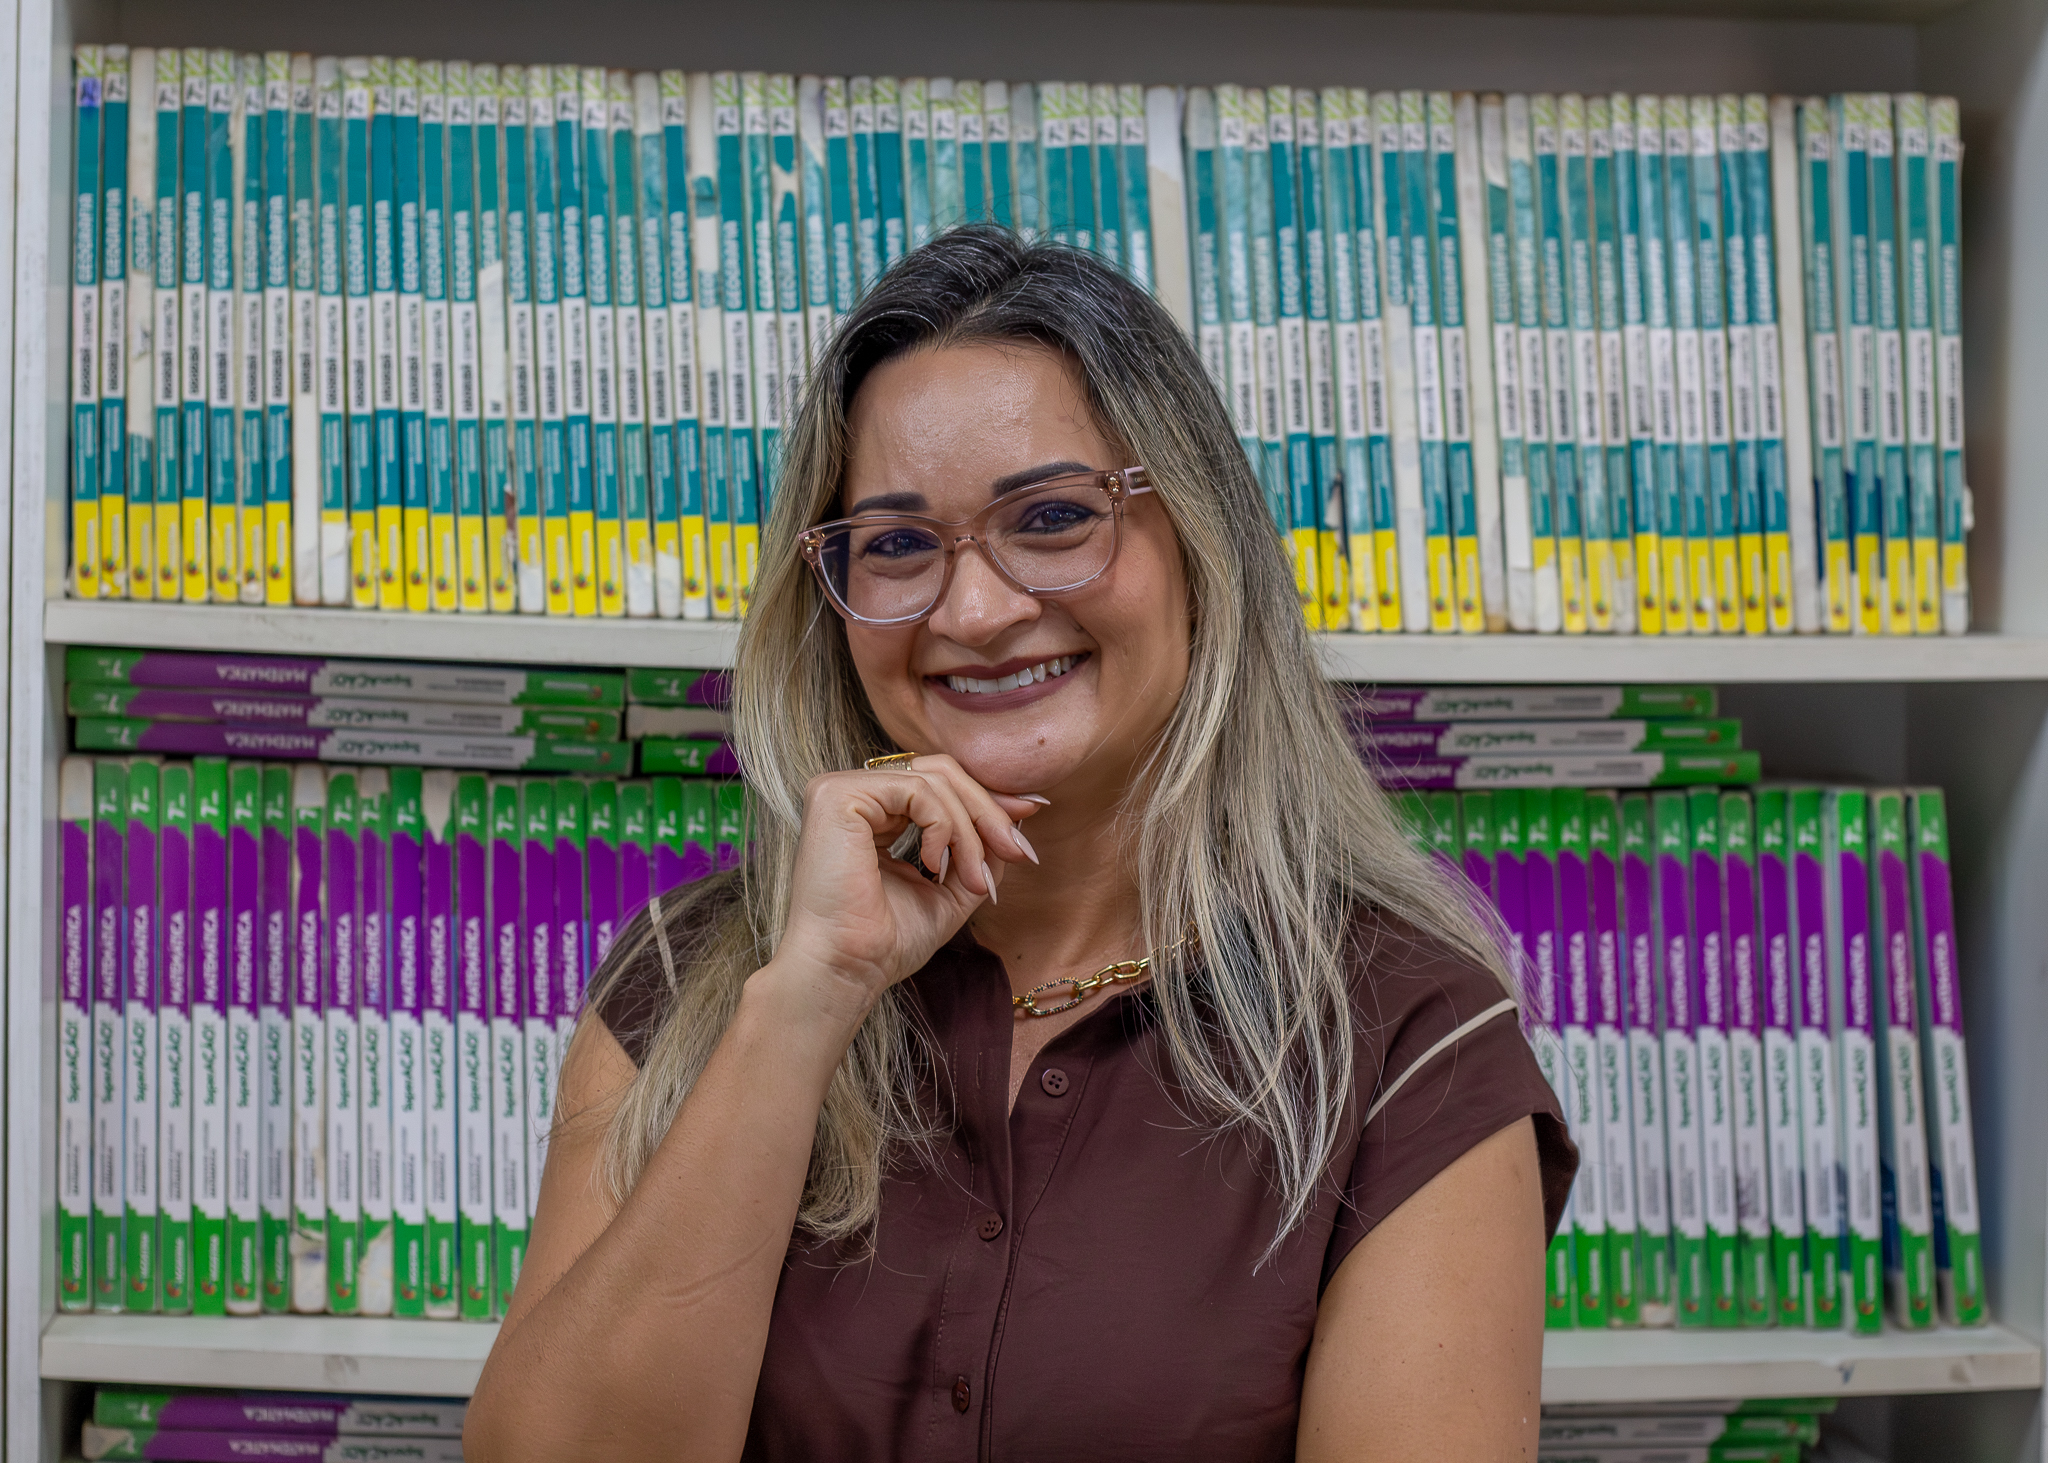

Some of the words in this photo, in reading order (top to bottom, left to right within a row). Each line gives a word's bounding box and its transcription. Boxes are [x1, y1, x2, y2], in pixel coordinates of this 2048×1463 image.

[78, 193, 93, 283] GEOGRAFIA
[106, 188, 122, 278] GEOGRAFIA
[158, 197, 174, 287] GEOGRAFIA
[186, 192, 200, 282] GEOGRAFIA
[213, 199, 228, 288] GEOGRAFIA
[244, 201, 258, 290] GEOGRAFIA
[269, 196, 285, 286] GEOGRAFIA
[297, 199, 312, 289] GEOGRAFIA
[321, 204, 336, 294] GEOGRAFIA
[348, 205, 363, 295] GEOGRAFIA
[375, 200, 392, 290] GEOGRAFIA
[402, 202, 418, 292] GEOGRAFIA
[426, 209, 442, 298] GEOGRAFIA
[454, 211, 470, 300] GEOGRAFIA
[508, 212, 525, 300] GEOGRAFIA
[537, 212, 552, 300] GEOGRAFIA
[563, 206, 580, 295] GEOGRAFIA
[590, 215, 606, 303] GEOGRAFIA
[618, 216, 633, 304] GEOGRAFIA
[644, 218, 661, 306] GEOGRAFIA
[670, 212, 686, 300] GEOGRAFIA
[724, 221, 742, 309] GEOGRAFIA
[756, 220, 774, 309] GEOGRAFIA
[779, 222, 796, 310] GEOGRAFIA
[808, 214, 827, 304] GEOGRAFIA
[212, 700, 304, 718] MATEMÁTICA
[216, 664, 308, 683] MATEMÁTICA
[224, 731, 316, 751] MATEMÁTICA
[67, 906, 80, 997] MATEMÁTICA
[102, 908, 115, 998] MATEMÁTICA
[134, 906, 148, 997] MATEMÁTICA
[170, 913, 184, 1003] MATEMÁTICA
[204, 910, 217, 1001] MATEMÁTICA
[238, 912, 251, 1003] MATEMÁTICA
[269, 913, 282, 1002] MATEMÁTICA
[302, 912, 316, 1002] MATEMÁTICA
[337, 915, 351, 1005] MATEMÁTICA
[366, 914, 380, 1003] MATEMÁTICA
[401, 918, 415, 1007] MATEMÁTICA
[431, 916, 445, 1006] MATEMÁTICA
[466, 919, 480, 1008] MATEMÁTICA
[501, 924, 514, 1014] MATEMÁTICA
[534, 925, 548, 1014] MATEMÁTICA
[66, 1020, 79, 1103] SuperAÇÃO!
[101, 1021, 113, 1102] SuperAÇÃO!
[132, 1019, 146, 1103] SuperAÇÃO!
[166, 1025, 181, 1109] SuperAÇÃO!
[201, 1023, 216, 1107] SuperAÇÃO!
[234, 1025, 250, 1108] SuperAÇÃO!
[266, 1023, 281, 1107] SuperAÇÃO!
[301, 1023, 314, 1107] SuperAÇÃO!
[335, 1027, 349, 1110] SuperAÇÃO!
[366, 1025, 379, 1110] SuperAÇÃO!
[400, 1028, 414, 1112] SuperAÇÃO!
[430, 1027, 445, 1111] SuperAÇÃO!
[466, 1030, 480, 1113] SuperAÇÃO!
[500, 1036, 515, 1118] SuperAÇÃO!
[534, 1036, 548, 1119] SuperAÇÃO!
[228, 1438, 320, 1456] MATEMÁTICA
[243, 1404, 336, 1422] MATEMÁTICA
